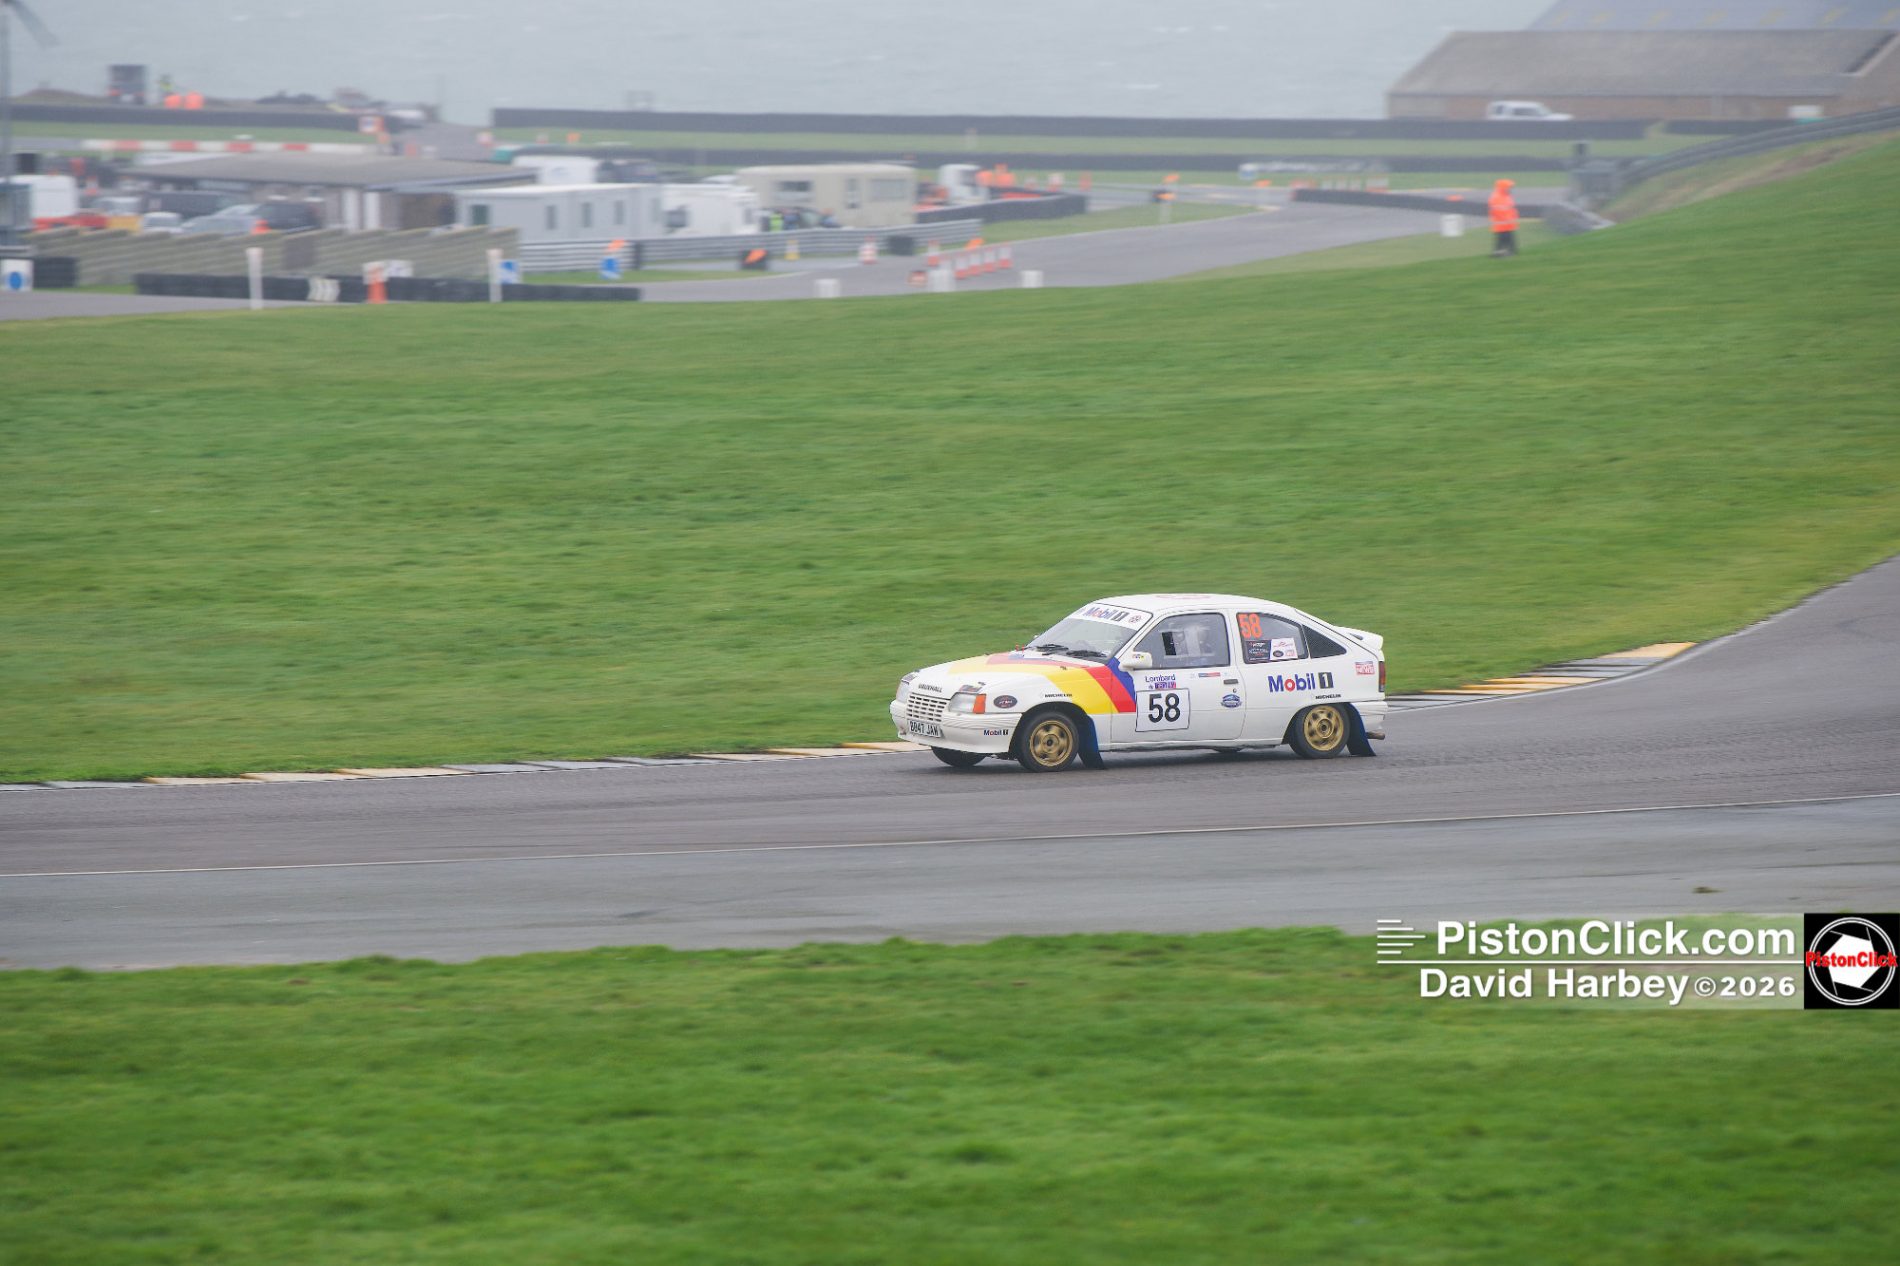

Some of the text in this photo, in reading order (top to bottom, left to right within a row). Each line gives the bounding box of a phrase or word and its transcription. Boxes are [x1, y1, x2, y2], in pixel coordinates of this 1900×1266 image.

[1083, 606, 1119, 620] Mobil
[1238, 613, 1263, 638] 58
[1145, 674, 1176, 683] Lombard
[1267, 672, 1316, 692] Mobil
[1148, 693, 1181, 723] 58
